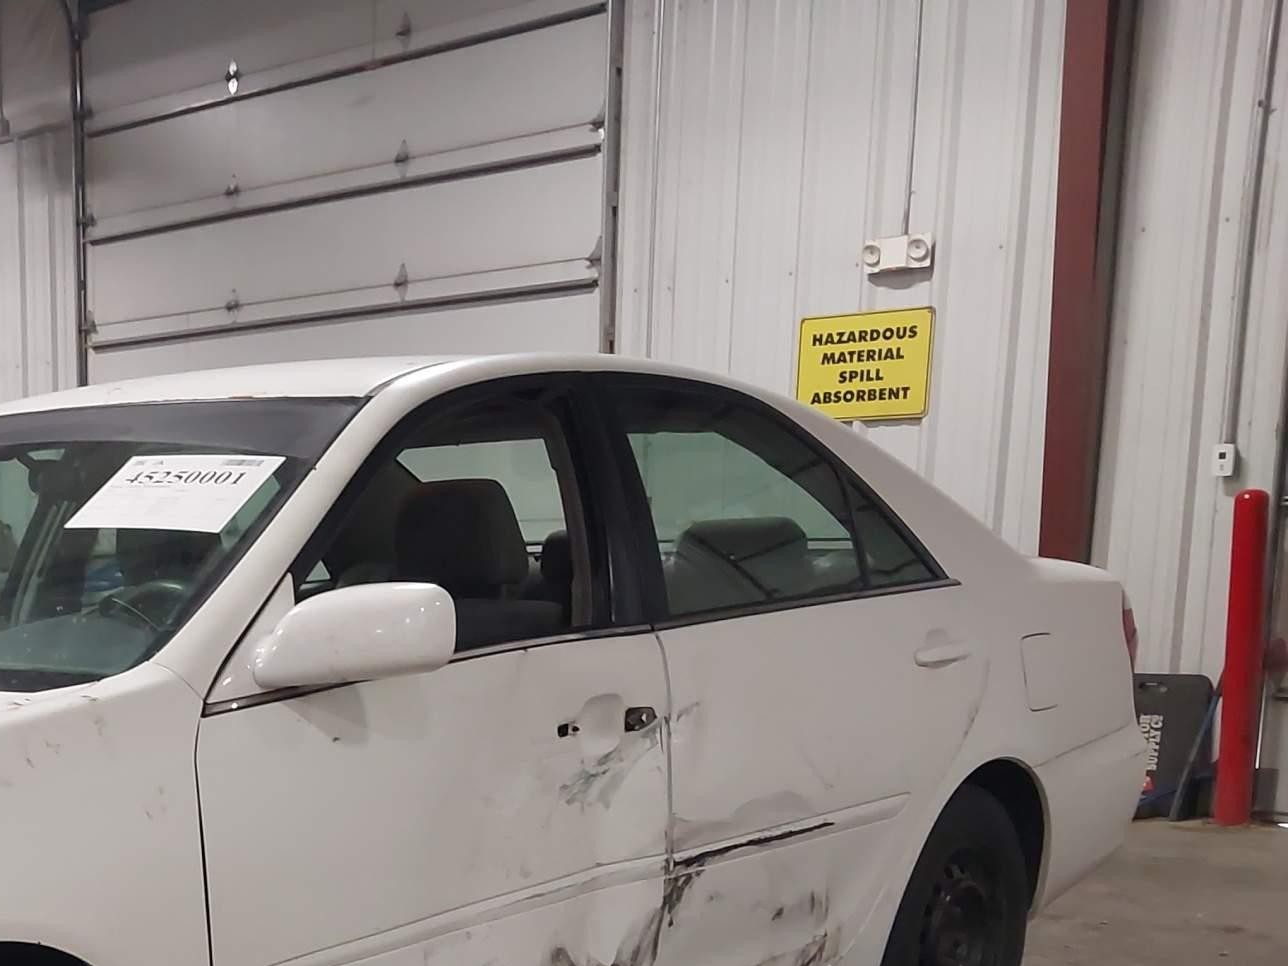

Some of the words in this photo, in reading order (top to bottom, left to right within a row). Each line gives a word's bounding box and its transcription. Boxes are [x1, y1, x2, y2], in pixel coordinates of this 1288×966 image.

[812, 325, 918, 347] HAZARDOUS
[821, 347, 905, 365] MATERIAL
[838, 368, 884, 384] SPILL
[810, 386, 911, 405] ABSORBENT
[125, 471, 247, 485] 45250001
